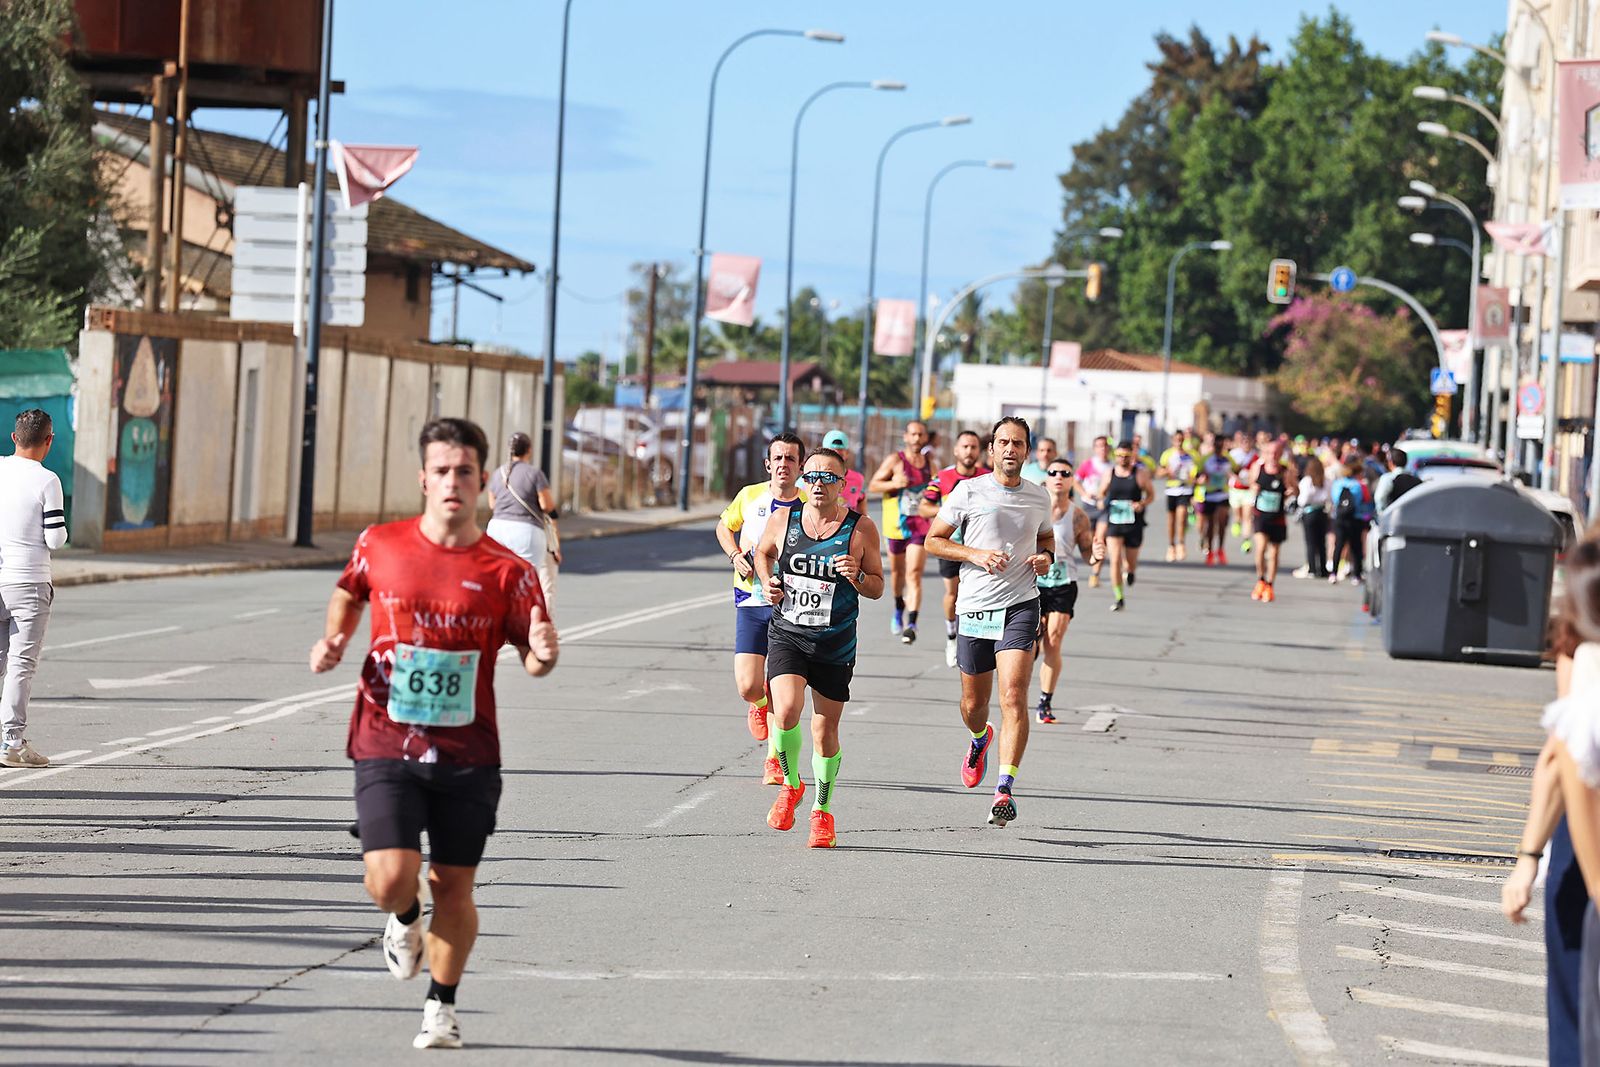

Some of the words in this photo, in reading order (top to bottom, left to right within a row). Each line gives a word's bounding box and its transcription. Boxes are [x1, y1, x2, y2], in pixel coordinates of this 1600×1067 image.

[789, 553, 836, 578] Giit
[819, 583, 831, 592] 2K
[791, 589, 821, 609] 109
[408, 670, 461, 697] 638
